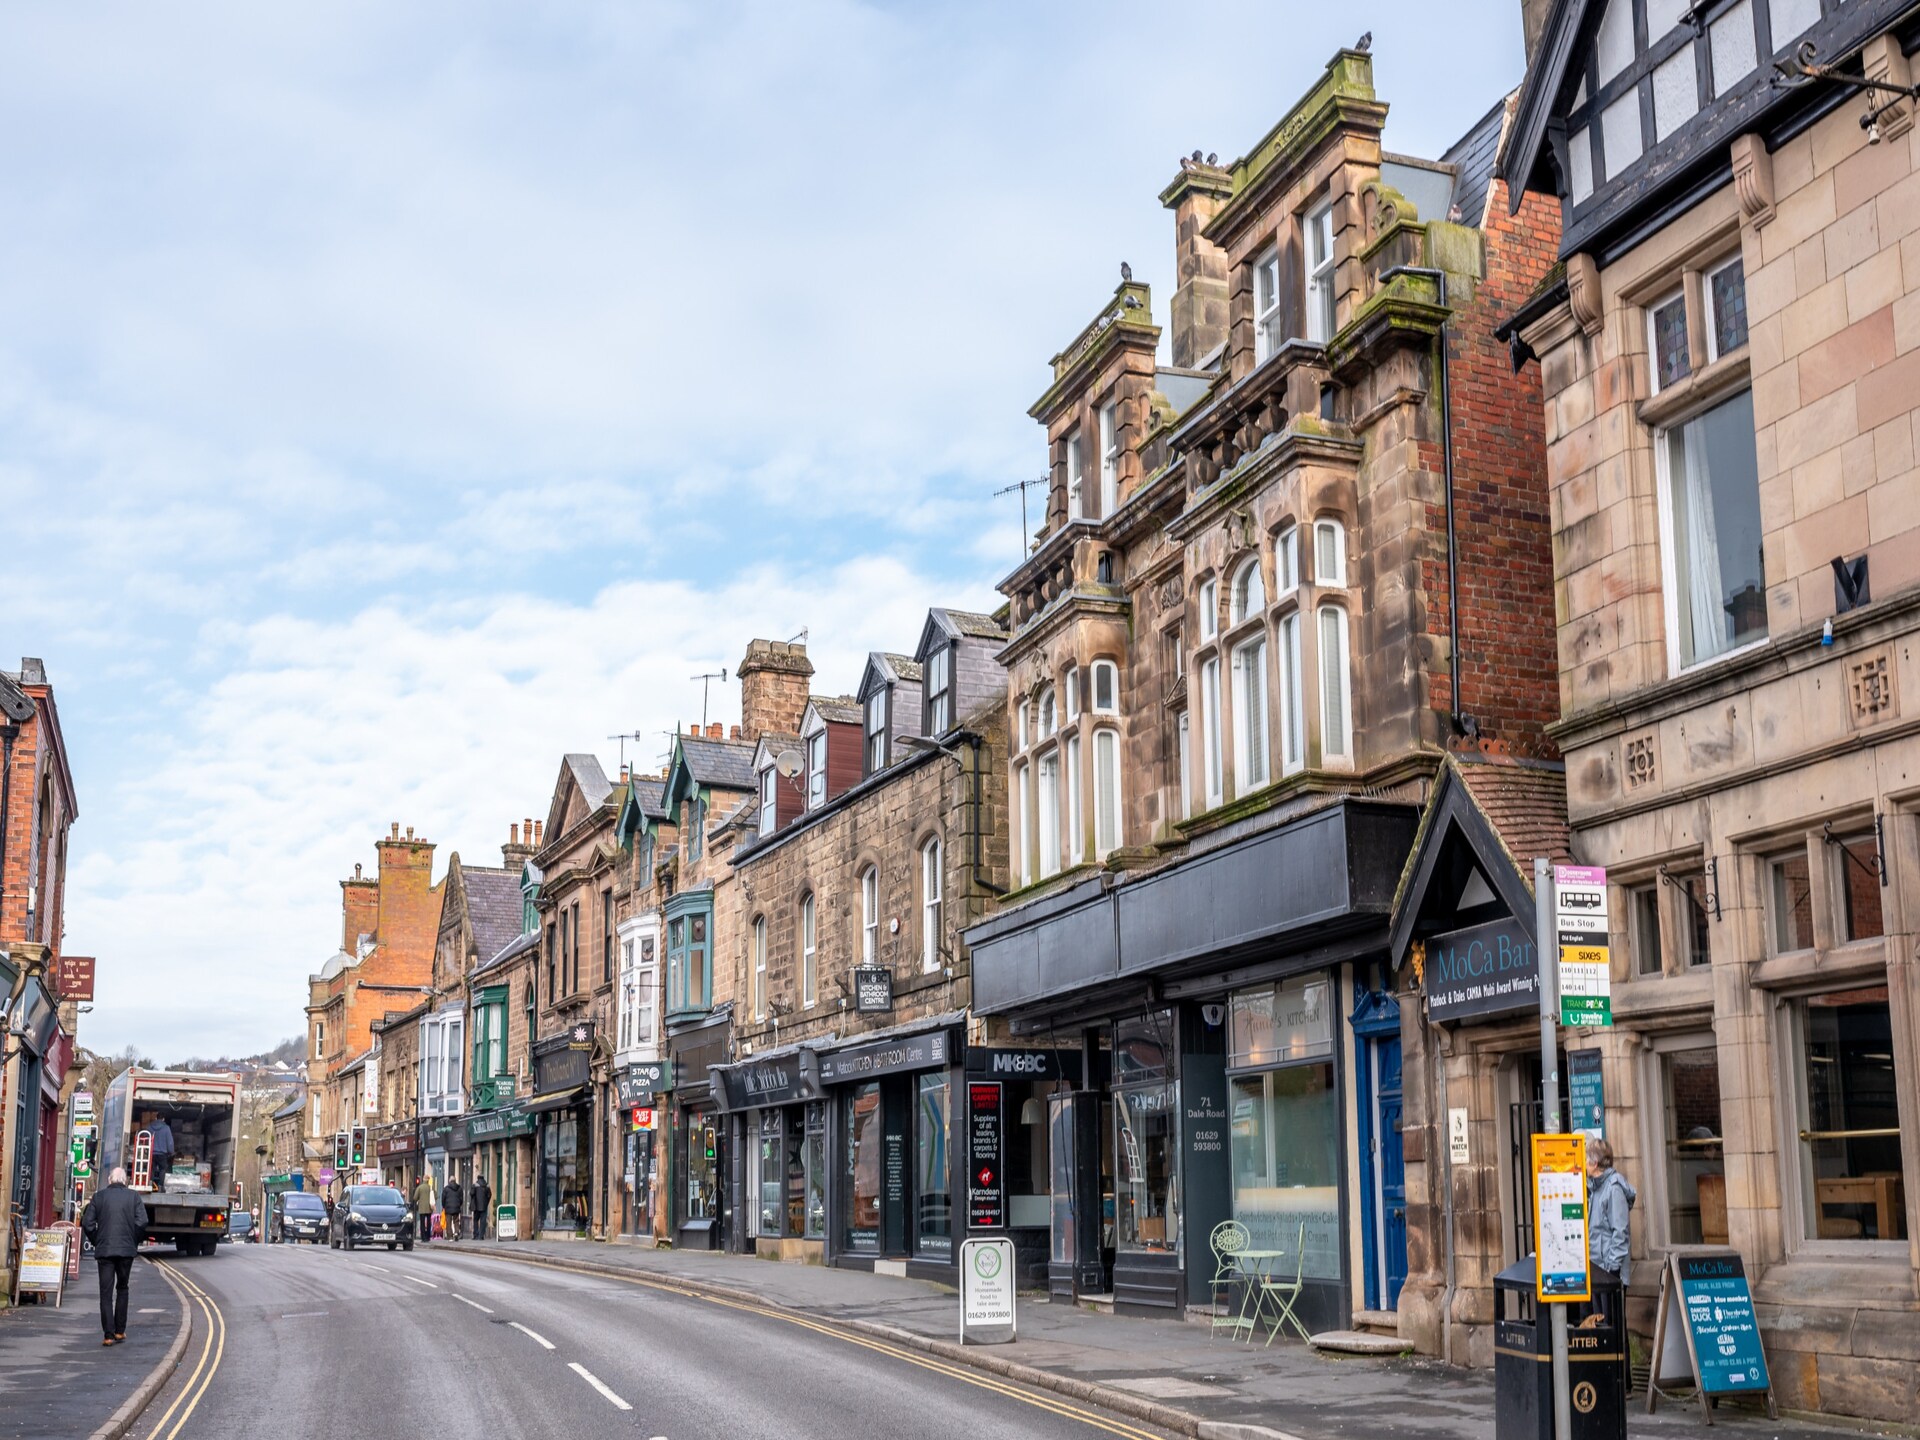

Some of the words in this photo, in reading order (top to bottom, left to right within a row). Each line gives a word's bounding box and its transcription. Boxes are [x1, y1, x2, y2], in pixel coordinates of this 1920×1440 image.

[1561, 919, 1575, 927] Bus
[1578, 919, 1595, 928] Stop
[1569, 934, 1584, 942] English
[1438, 940, 1495, 984] MoCa
[1496, 934, 1532, 971] Bar
[1578, 951, 1601, 961] sixes
[861, 984, 883, 992] KITCHEN
[1429, 993, 1447, 1008] Matlock
[1447, 991, 1452, 1005] &
[1453, 990, 1466, 1003] Dales
[1466, 986, 1482, 1000] CAMRA
[1483, 983, 1495, 997] Multi
[1496, 980, 1512, 995] Award
[1511, 976, 1533, 992] Winning
[859, 990, 889, 998] BATHROOM
[864, 997, 885, 1005] CENTRE
[1287, 1008, 1320, 1027] KITCHEN
[852, 1055, 873, 1073] KITCHEN
[877, 1049, 906, 1069] BATHROOM
[906, 1047, 923, 1062] Centre
[993, 1053, 1047, 1073] MK&BC
[632, 1067, 650, 1076] STAR
[632, 1079, 651, 1087] PIZZA
[1591, 1074, 1601, 1084] FOR
[970, 1086, 999, 1094] DERWENT
[974, 1101, 997, 1109] LIMITED
[1200, 1096, 1211, 1107] 71
[635, 1110, 650, 1118] JUST
[1187, 1109, 1205, 1118] Dale
[1206, 1109, 1226, 1118] Road
[638, 1115, 649, 1123] EAT
[973, 1114, 997, 1123] Suppliers
[975, 1129, 995, 1138] leading
[1195, 1130, 1219, 1140] 01629
[1453, 1135, 1464, 1143] PUB
[973, 1144, 993, 1152] carpets
[1193, 1141, 1221, 1151] 593800
[1451, 1143, 1468, 1151] WATCH
[975, 1151, 996, 1160] flooring
[971, 1187, 1000, 1196] Karndean
[1239, 1211, 1273, 1223] Sandwiches
[1297, 1211, 1319, 1224] Drinks
[1250, 1230, 1267, 1241] acket
[1307, 1230, 1329, 1243] Cream
[1689, 1261, 1717, 1276] MoCa
[1717, 1260, 1734, 1274] Bar
[1727, 1295, 1748, 1303] monkey
[987, 1310, 1011, 1319] 593800
[1691, 1313, 1712, 1322] DUCK
[1506, 1332, 1526, 1346] LITTER
[1718, 1345, 1737, 1356] ISLAND
